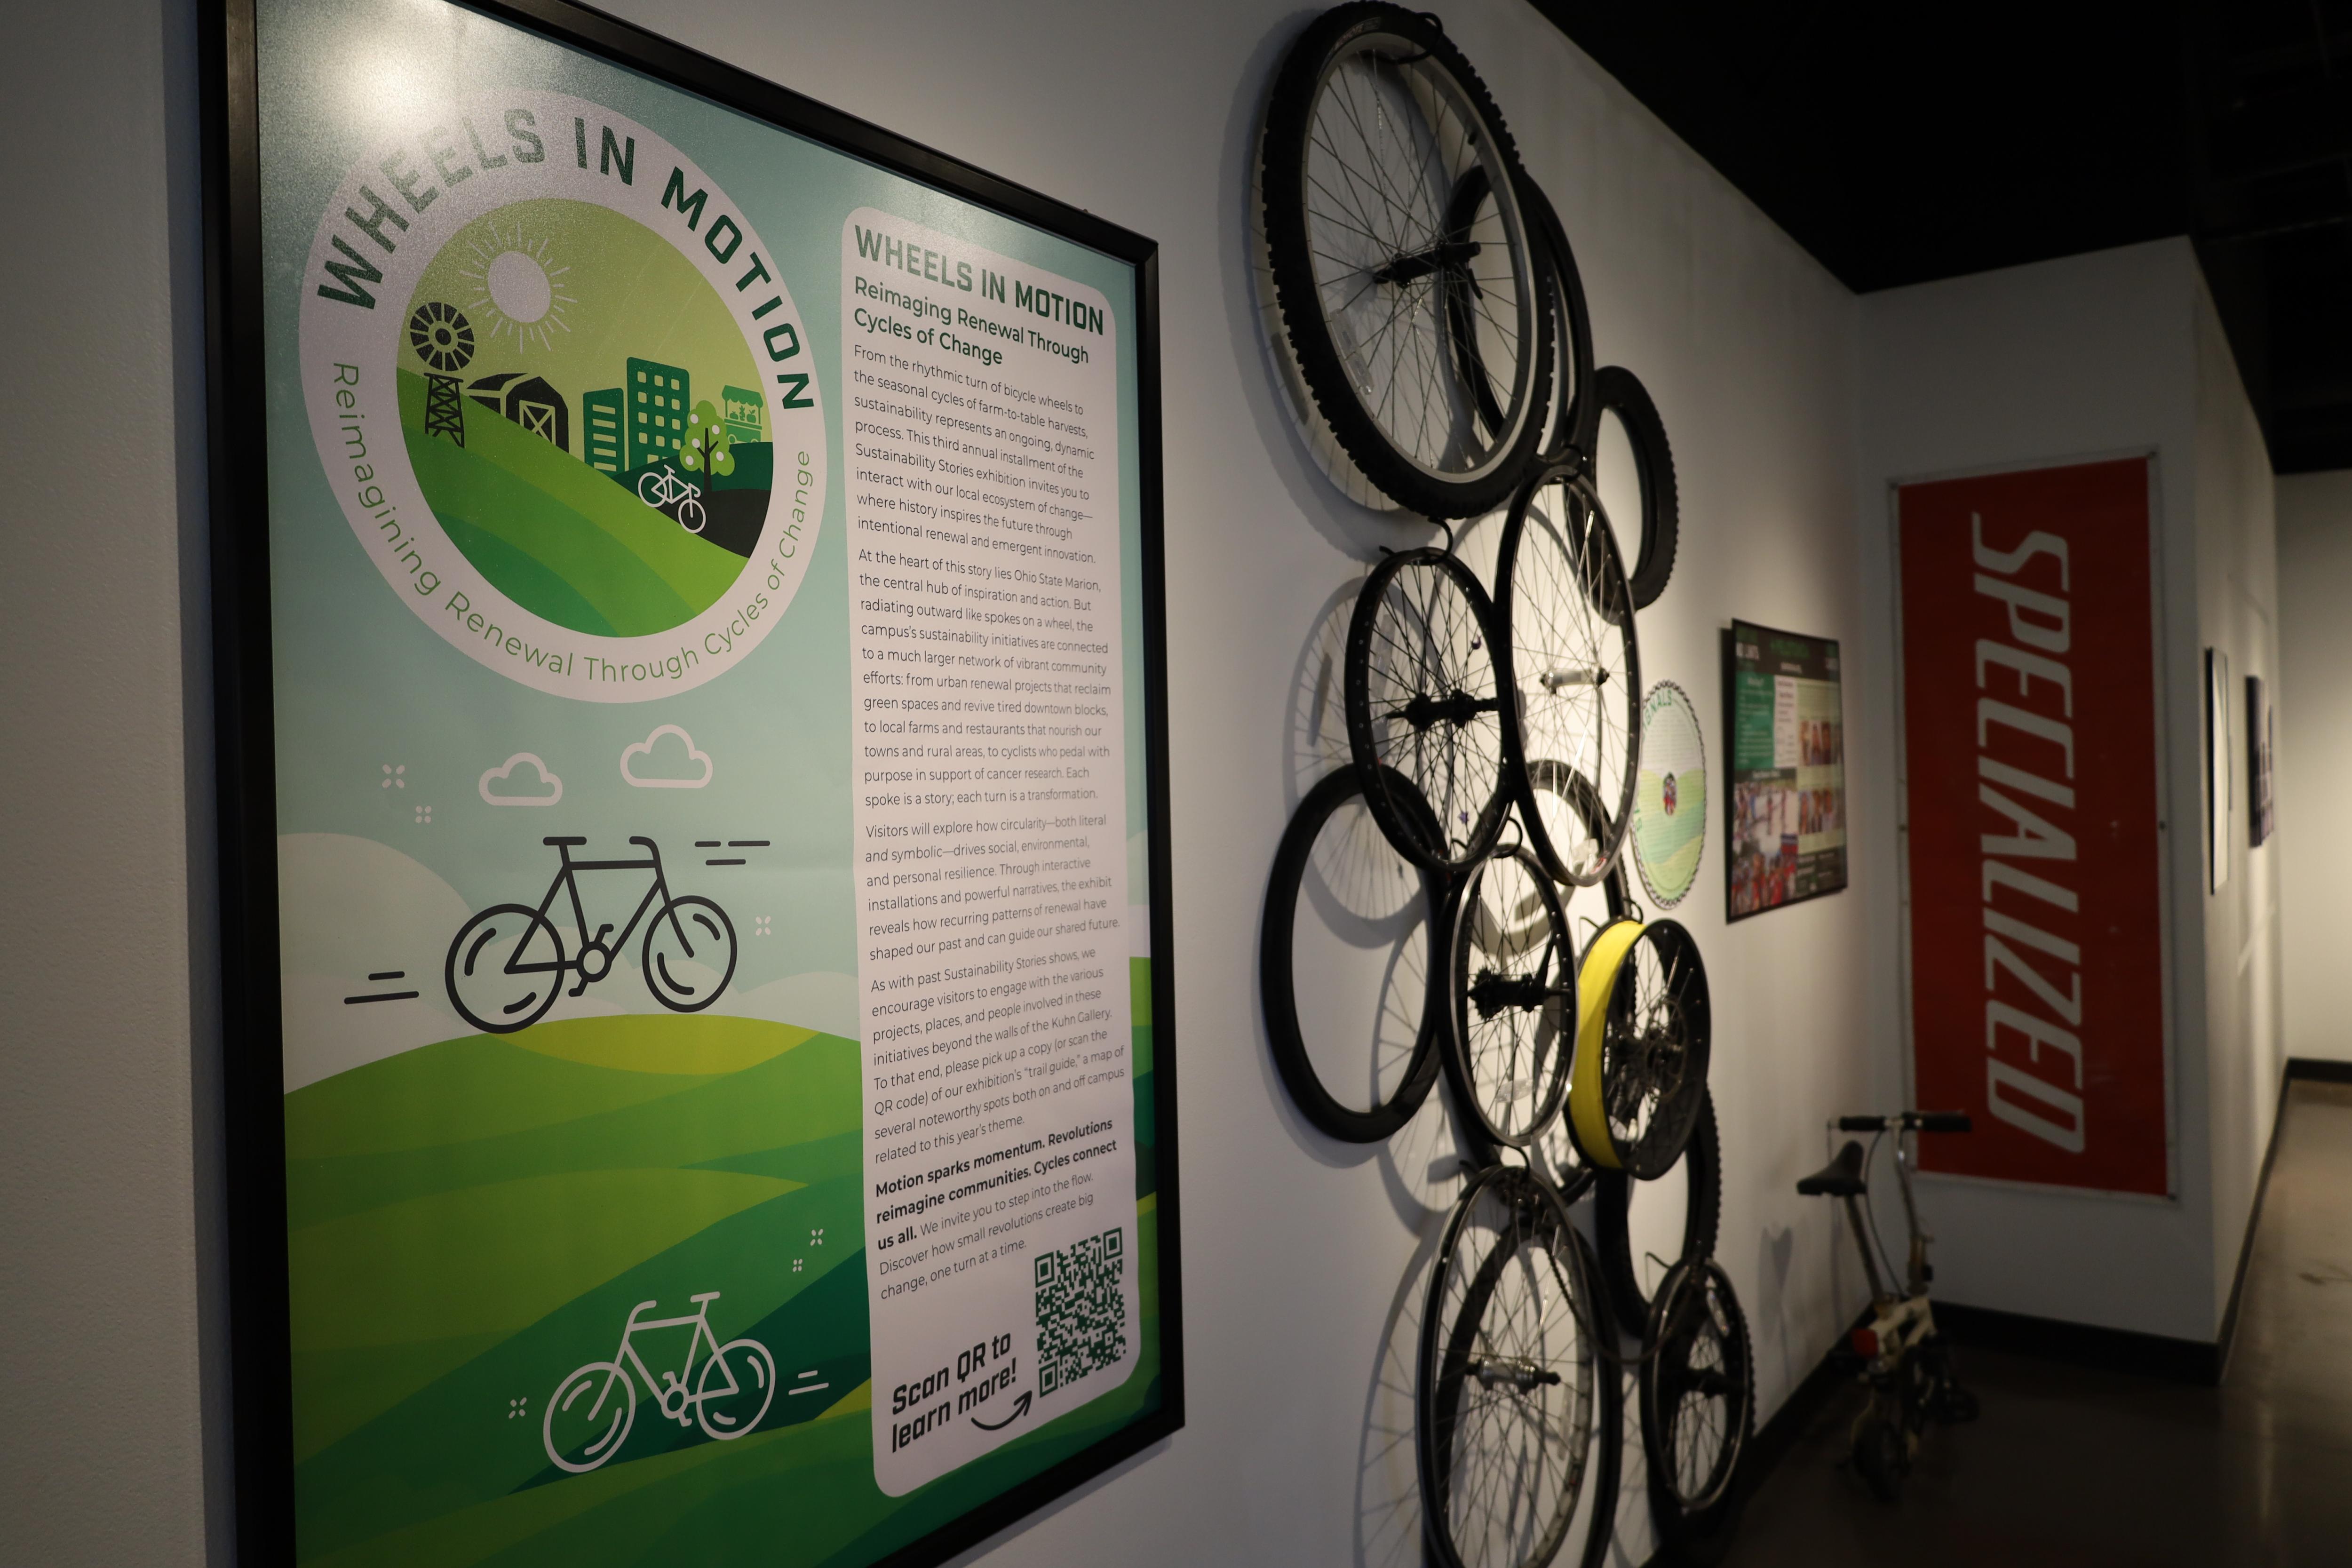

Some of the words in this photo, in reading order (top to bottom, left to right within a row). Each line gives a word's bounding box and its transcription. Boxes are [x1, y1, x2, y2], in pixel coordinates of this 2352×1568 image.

[317, 108, 545, 310] WHEELS
[574, 117, 635, 186] IN
[660, 166, 814, 410] MOTION
[854, 224, 973, 292] WHEELS
[982, 269, 1006, 304] IN
[1015, 279, 1104, 336] MOTION
[854, 307, 912, 340] Cycles
[916, 327, 935, 346] of
[939, 332, 1003, 366] Change
[855, 275, 952, 326] Reimaging
[957, 307, 1024, 344] Renewal
[1027, 329, 1089, 365] Through
[853, 369, 874, 385] the
[877, 378, 928, 398] seasonal
[931, 390, 964, 407] cycles
[967, 398, 977, 410] of
[978, 399, 1046, 427] farm-to-table
[1048, 417, 1088, 439] harvests,
[855, 344, 886, 365] From
[889, 354, 909, 370] the
[912, 360, 963, 384] rhythmic
[965, 374, 988, 390] turn
[991, 382, 1002, 393] of
[1004, 383, 1036, 403] bicycle
[1038, 395, 1073, 413] wheels
[1074, 404, 1084, 415] to
[854, 397, 933, 425] sustainability
[936, 414, 992, 436] represents
[995, 429, 1007, 440] an
[1009, 432, 1053, 452] ongoing,
[1055, 440, 1095, 460] dynamic
[855, 421, 904, 440] process.
[906, 429, 930, 446] This
[932, 435, 959, 452] third
[962, 444, 998, 460] annual
[1001, 449, 1056, 472] installment
[1057, 463, 1067, 475] of
[1068, 465, 1083, 478] the
[856, 443, 936, 472] Sustainability
[938, 459, 974, 478] Stories
[976, 469, 1026, 488] exhibition
[1029, 477, 1059, 494] invites
[1060, 487, 1077, 498] you
[1080, 489, 1089, 500] to
[857, 466, 904, 487] interact
[906, 478, 932, 492] with
[935, 484, 954, 496] our
[956, 485, 980, 501] local
[982, 493, 1035, 511] ecosystem
[1038, 501, 1048, 513] of
[333, 362, 442, 596] Reimagining
[445, 591, 573, 677] Renewal
[584, 646, 699, 682] Through
[704, 592, 768, 655] Cycles
[767, 559, 785, 590] of
[779, 450, 813, 558] Change
[857, 493, 896, 509] where
[899, 498, 938, 519] history
[941, 505, 981, 524] inspires
[983, 513, 999, 527] the
[1001, 516, 1033, 533] future
[1035, 522, 1073, 541] through
[858, 516, 922, 538] intentional
[926, 529, 968, 544] renewal
[971, 536, 989, 548] and
[992, 540, 1042, 556] emergent
[1045, 545, 1096, 564] innovation.
[858, 549, 873, 562] At
[875, 550, 896, 565] the
[899, 553, 930, 569] heart
[932, 558, 944, 571] of
[945, 560, 966, 574] this
[968, 565, 992, 580] story
[995, 566, 1012, 580] lies
[1014, 569, 1037, 583] Ohio
[1039, 573, 1063, 587] State
[861, 625, 917, 639] campus's
[919, 629, 989, 647] sustainability
[992, 633, 1039, 648] initiatives
[1041, 640, 1055, 650] are
[1057, 642, 1108, 654] connected
[865, 771, 913, 785] purpose
[916, 768, 926, 780] in
[929, 769, 972, 783] support
[974, 767, 985, 780] of
[987, 770, 1022, 780] cancer
[1025, 767, 1064, 779] research.
[1066, 767, 1089, 778] Each
[1971, 511, 2084, 1153] SPECIALIZED
[866, 872, 890, 887] and
[893, 868, 941, 888] personal
[945, 866, 997, 880] resilience.
[999, 861, 1040, 876] Through
[1042, 859, 1091, 871] interactive
[868, 894, 938, 911] installations
[940, 890, 961, 904] and
[964, 885, 1010, 905] powerful
[1013, 883, 1059, 896] narratives,
[1061, 880, 1076, 891] the
[1078, 876, 1112, 889] exhibit
[871, 979, 886, 993] As
[888, 974, 914, 990] with
[918, 971, 941, 988] past
[944, 960, 1014, 981] Sustainability
[1016, 956, 1047, 970] Stories
[1081, 949, 1096, 958] we
[875, 1141, 916, 1164] related
[919, 1140, 931, 1152] to
[933, 1132, 954, 1148] this
[956, 1123, 986, 1145] year's
[988, 1116, 1025, 1133] theme.
[876, 1174, 924, 1198] Motion
[927, 1160, 970, 1184] sparks
[974, 1139, 1045, 1169] momentum.
[1048, 1119, 1113, 1146] Revolutions
[876, 1193, 946, 1225] reimagine
[948, 1167, 1032, 1201] communities.
[1033, 1154, 1071, 1176] Cycles
[1072, 1139, 1117, 1162] connect
[877, 1235, 894, 1250] us
[898, 1226, 917, 1244] all.
[920, 1221, 938, 1236] We
[941, 1211, 971, 1229] invite
[972, 1204, 992, 1222] you
[994, 1201, 1006, 1211] to
[1009, 1193, 1030, 1208] step
[1031, 1186, 1051, 1199] into
[1052, 1179, 1070, 1193] the
[1071, 1173, 1093, 1186] flow.
[880, 1249, 929, 1275] Discover
[931, 1240, 955, 1258] how
[957, 1226, 985, 1248] small
[988, 1210, 1043, 1237] revolutions
[1045, 1200, 1076, 1217] create
[1078, 1193, 1093, 1207] big
[881, 1276, 928, 1300] change,
[930, 1266, 951, 1282] one
[953, 1257, 977, 1273] turn
[978, 1250, 989, 1264] at
[991, 1249, 998, 1259] a
[1000, 1240, 1026, 1256] time.
[892, 1367, 949, 1415] Scan
[957, 1342, 986, 1383] QR
[992, 1333, 1011, 1360] to
[892, 1401, 951, 1453] learn
[958, 1357, 1016, 1415] more!
